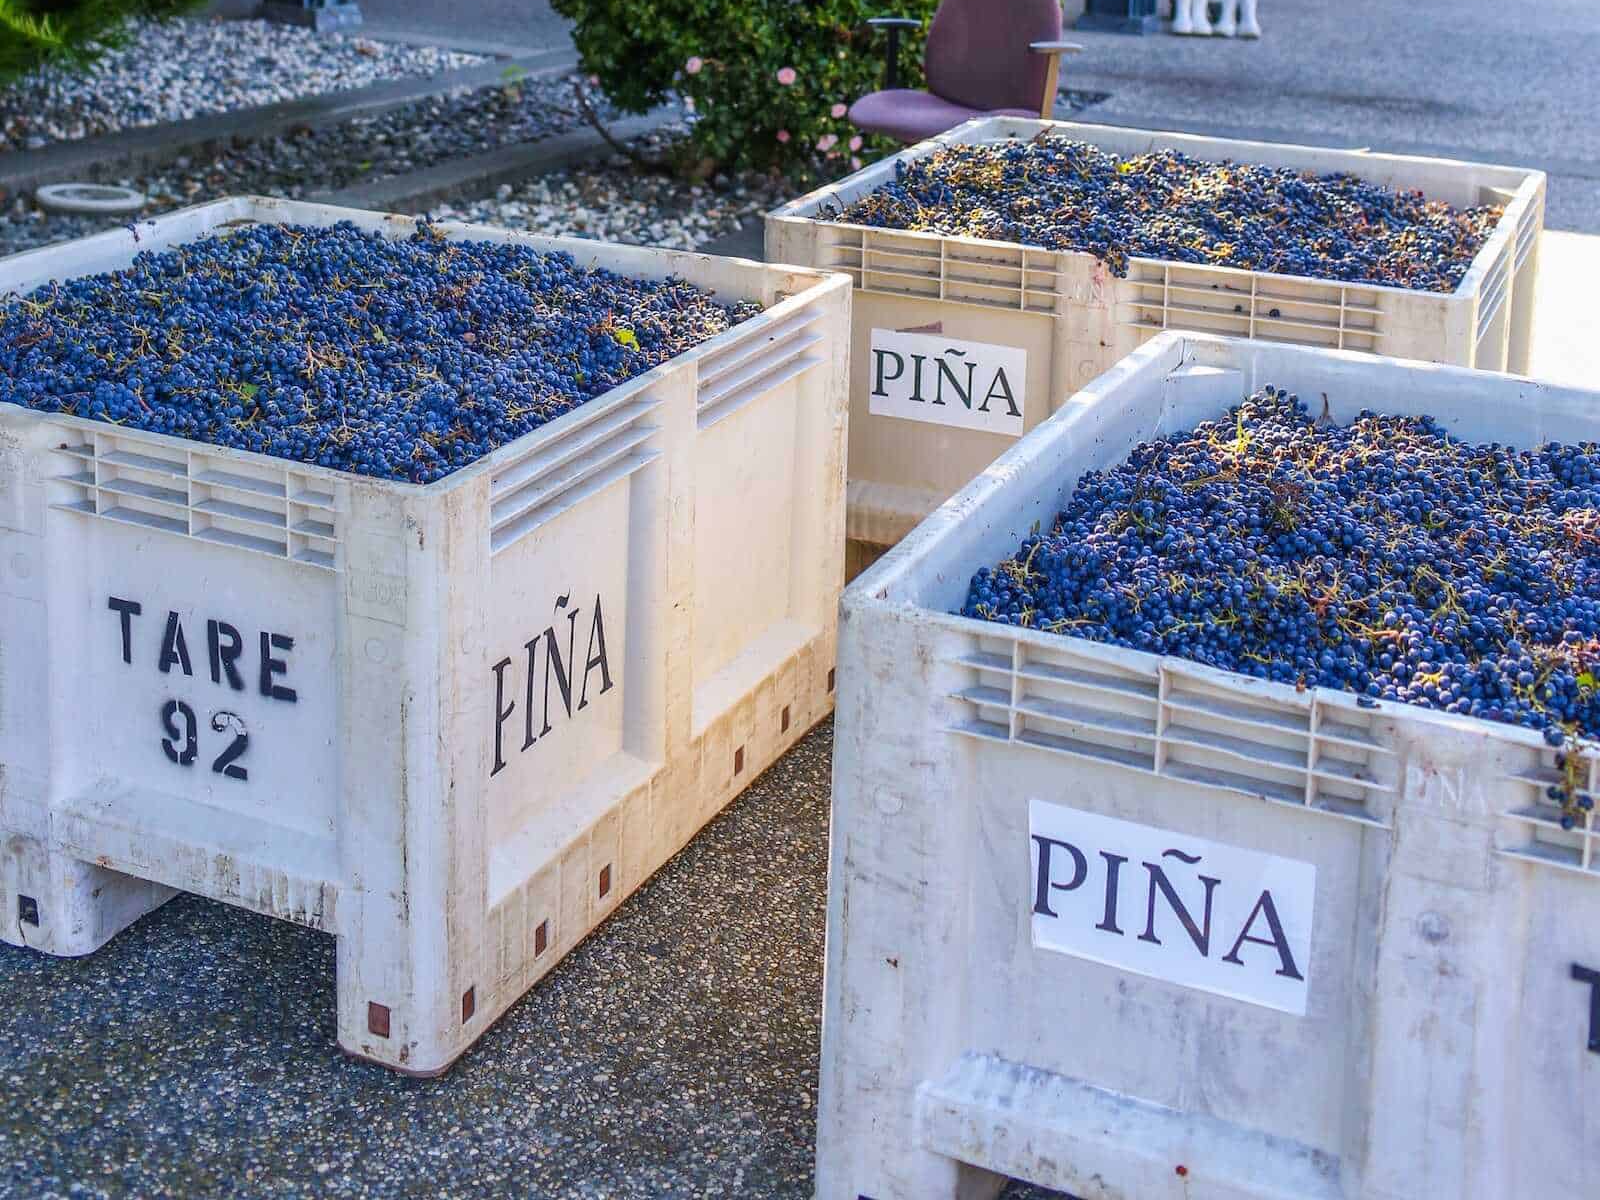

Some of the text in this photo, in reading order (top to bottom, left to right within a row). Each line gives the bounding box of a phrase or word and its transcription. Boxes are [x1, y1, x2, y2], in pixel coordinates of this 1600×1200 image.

[872, 348, 1022, 417] PIÑA
[108, 596, 298, 703] TARE
[161, 699, 250, 782] 92
[1031, 833, 1305, 982] PIÑA
